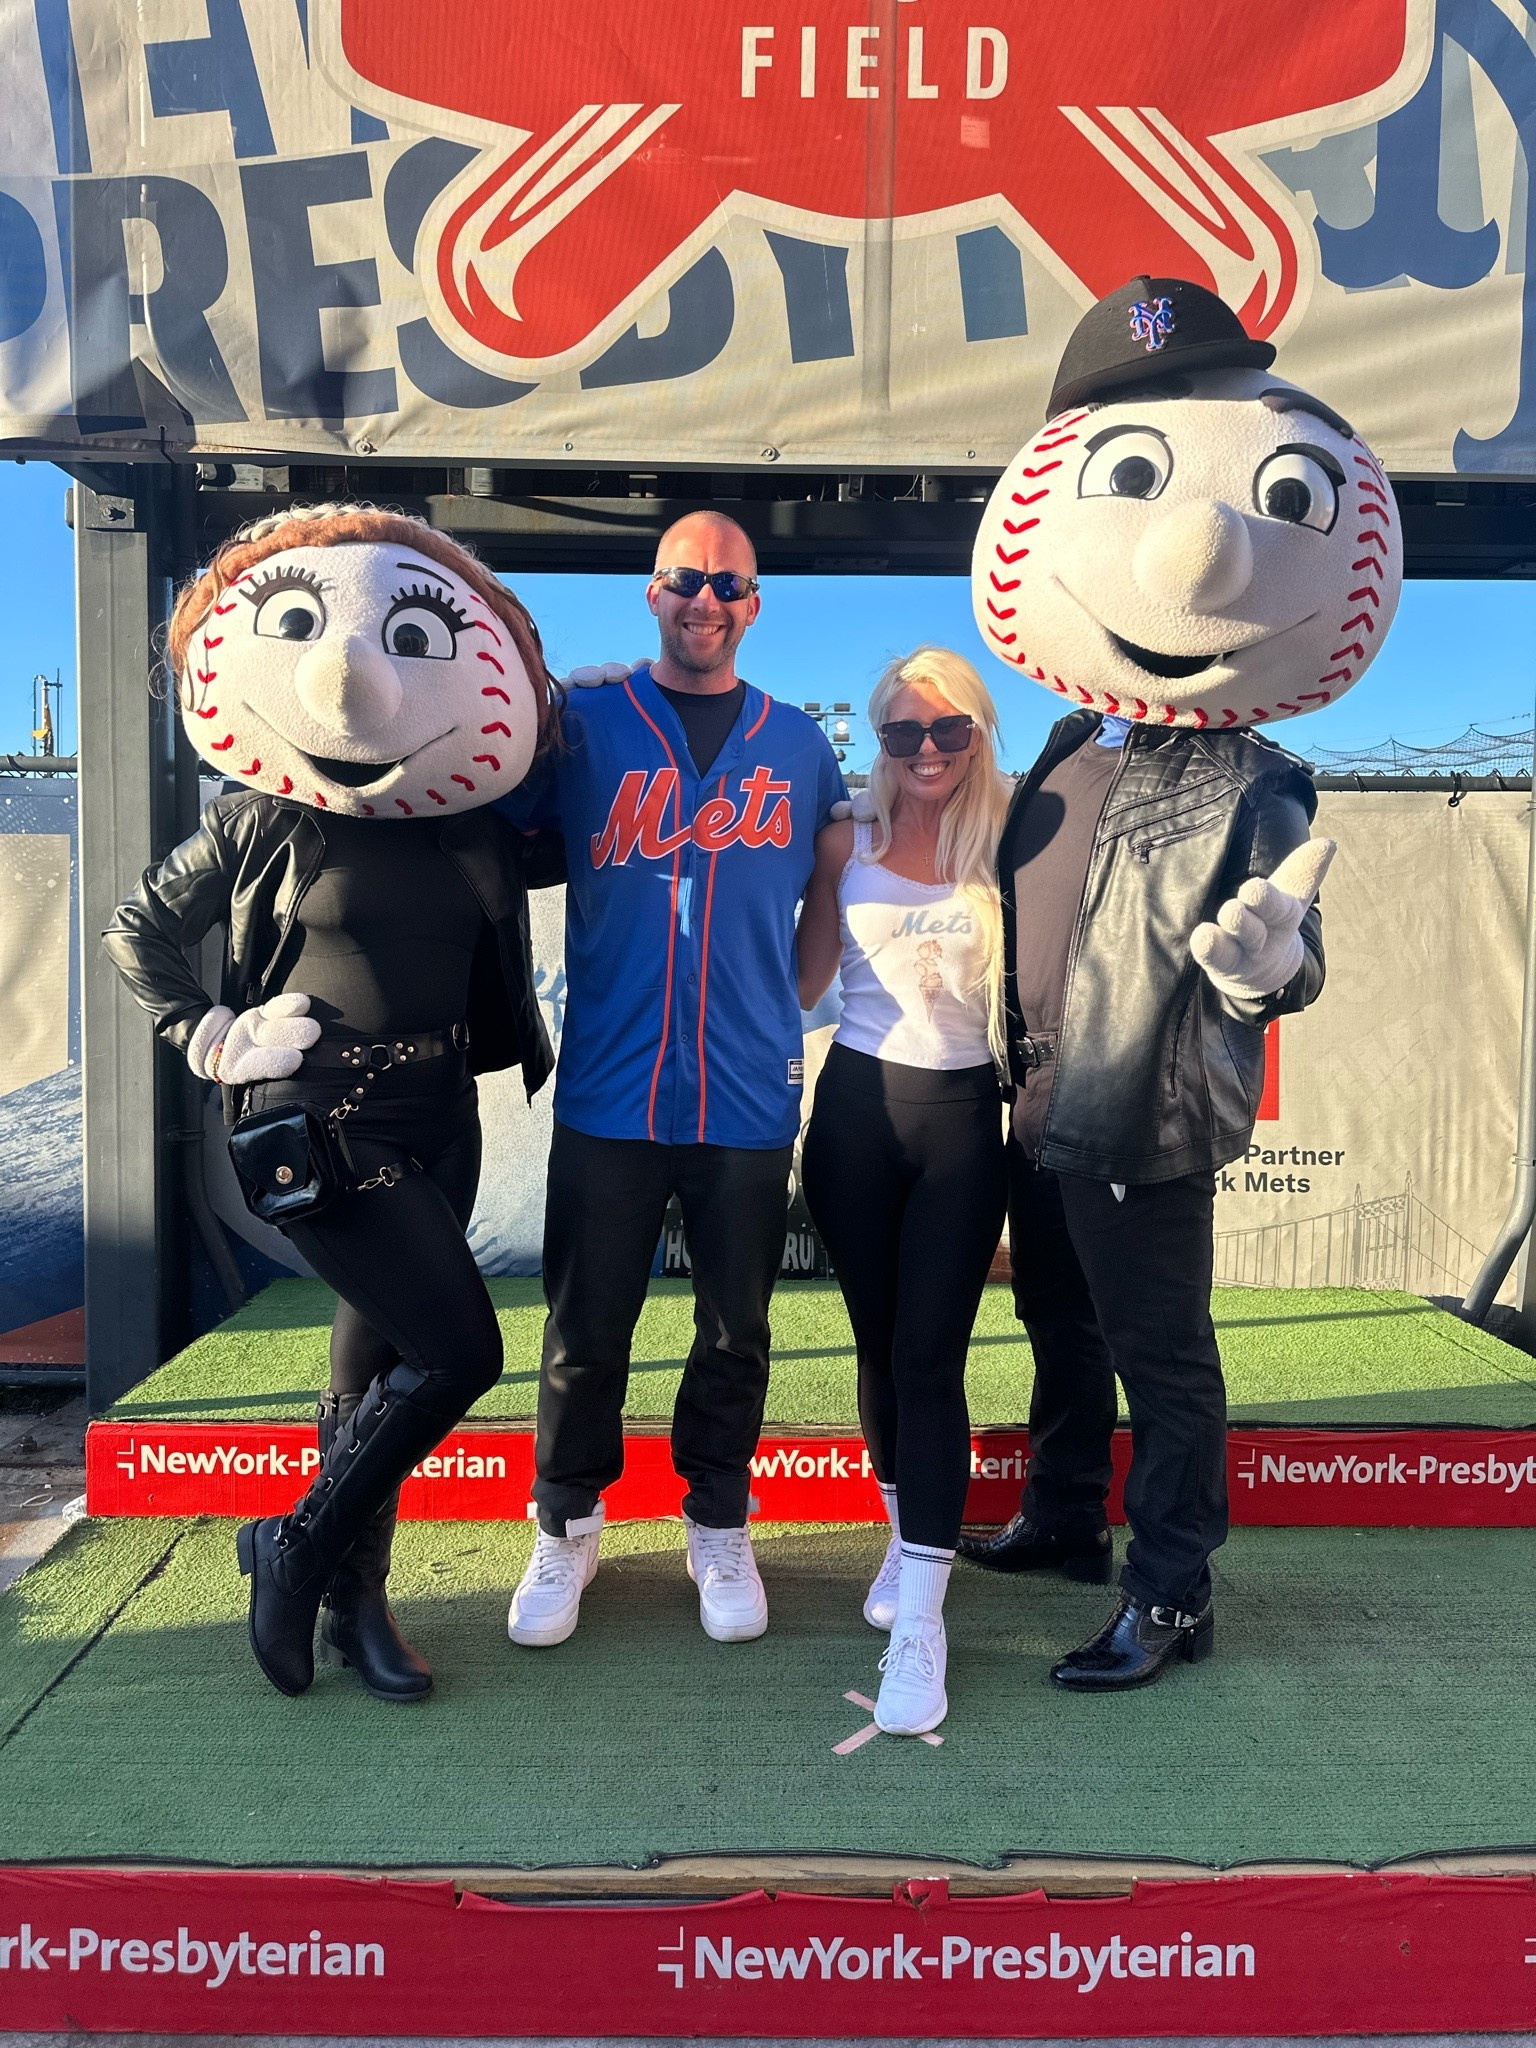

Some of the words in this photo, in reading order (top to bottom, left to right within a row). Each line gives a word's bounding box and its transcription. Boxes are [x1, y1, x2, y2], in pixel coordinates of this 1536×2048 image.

[741, 26, 1008, 99] FIELD
[591, 766, 791, 869] Mets
[891, 910, 972, 938] Mets
[1244, 1144, 1345, 1165] Partner
[1245, 1172, 1310, 1192] Mets
[694, 1932, 1255, 1993] NewYork-Presbyterian
